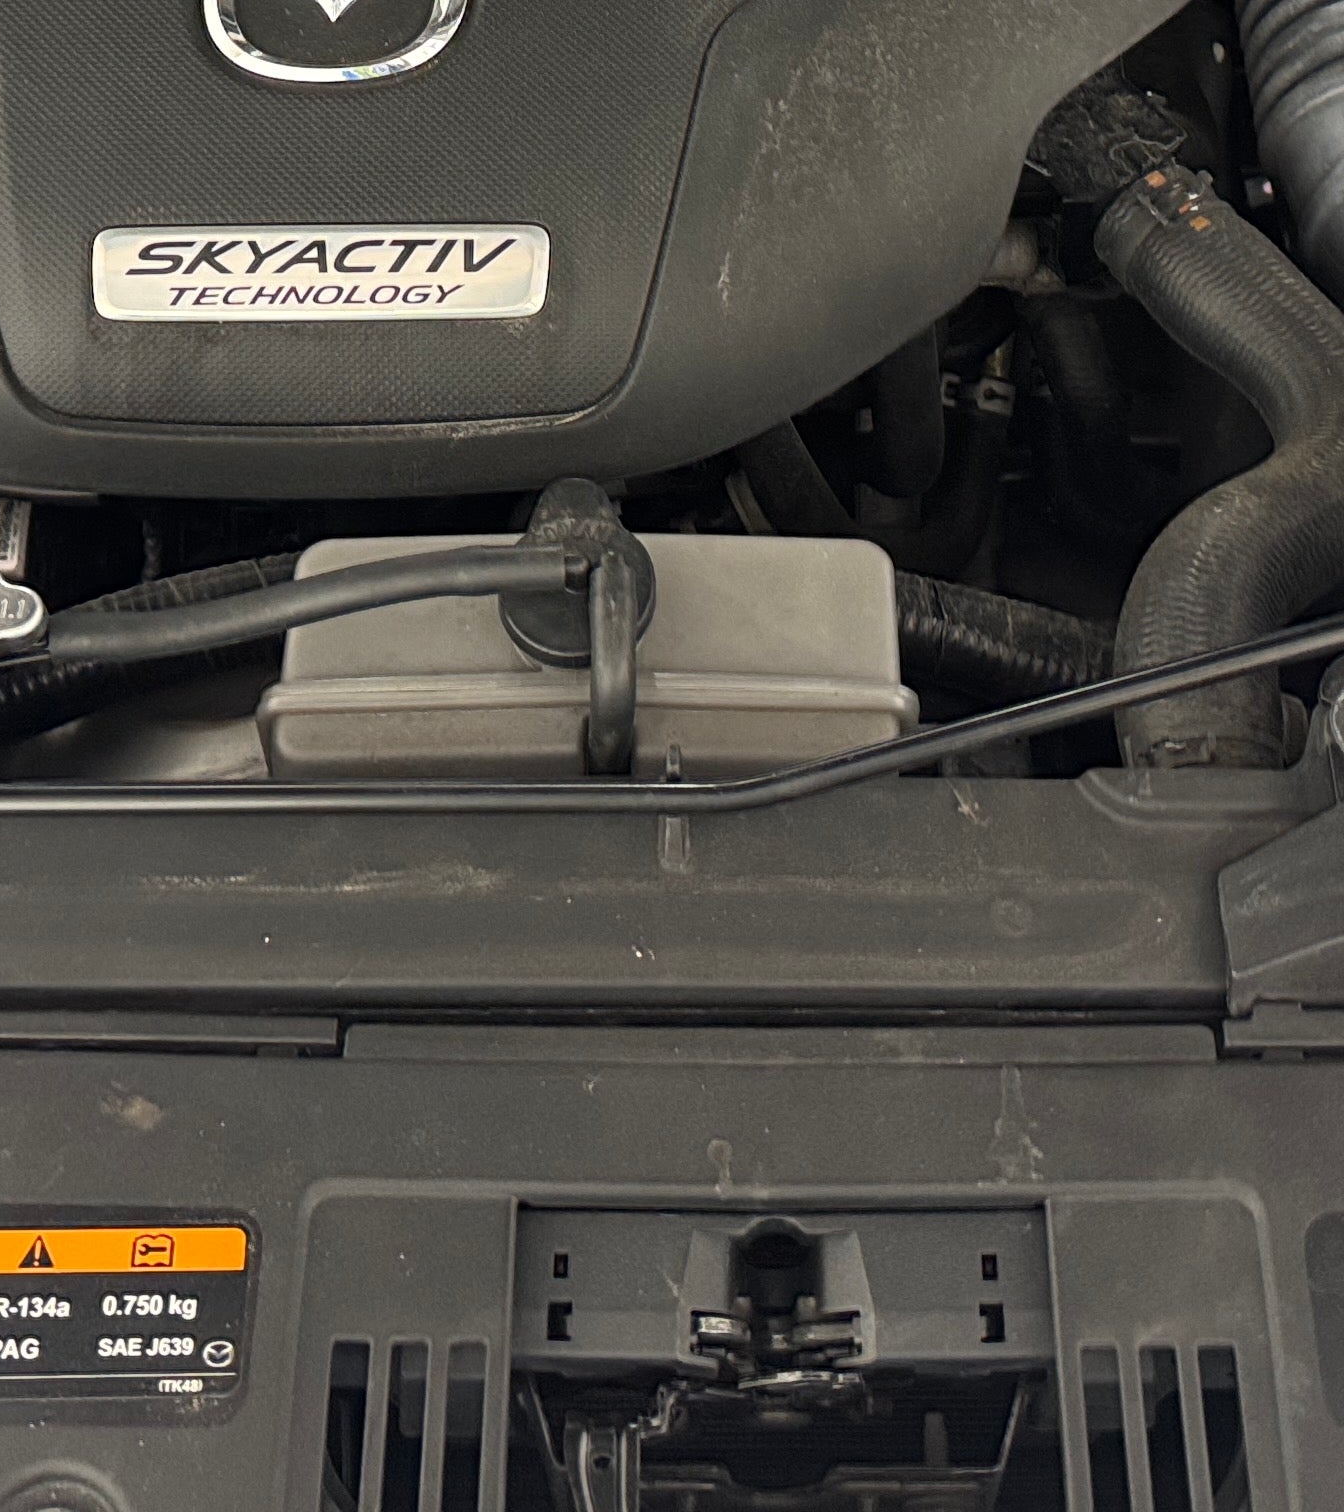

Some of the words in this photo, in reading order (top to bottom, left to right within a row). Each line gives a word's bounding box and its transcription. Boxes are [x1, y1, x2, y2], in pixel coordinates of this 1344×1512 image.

[125, 238, 519, 276] SKYACTIV
[168, 284, 464, 307] TECHNOLOGY
[0, 598, 26, 619] 1.1
[102, 1294, 163, 1316] 0.750
[168, 1293, 198, 1320] kg
[98, 1338, 142, 1358] SAE
[146, 1337, 194, 1357] J639
